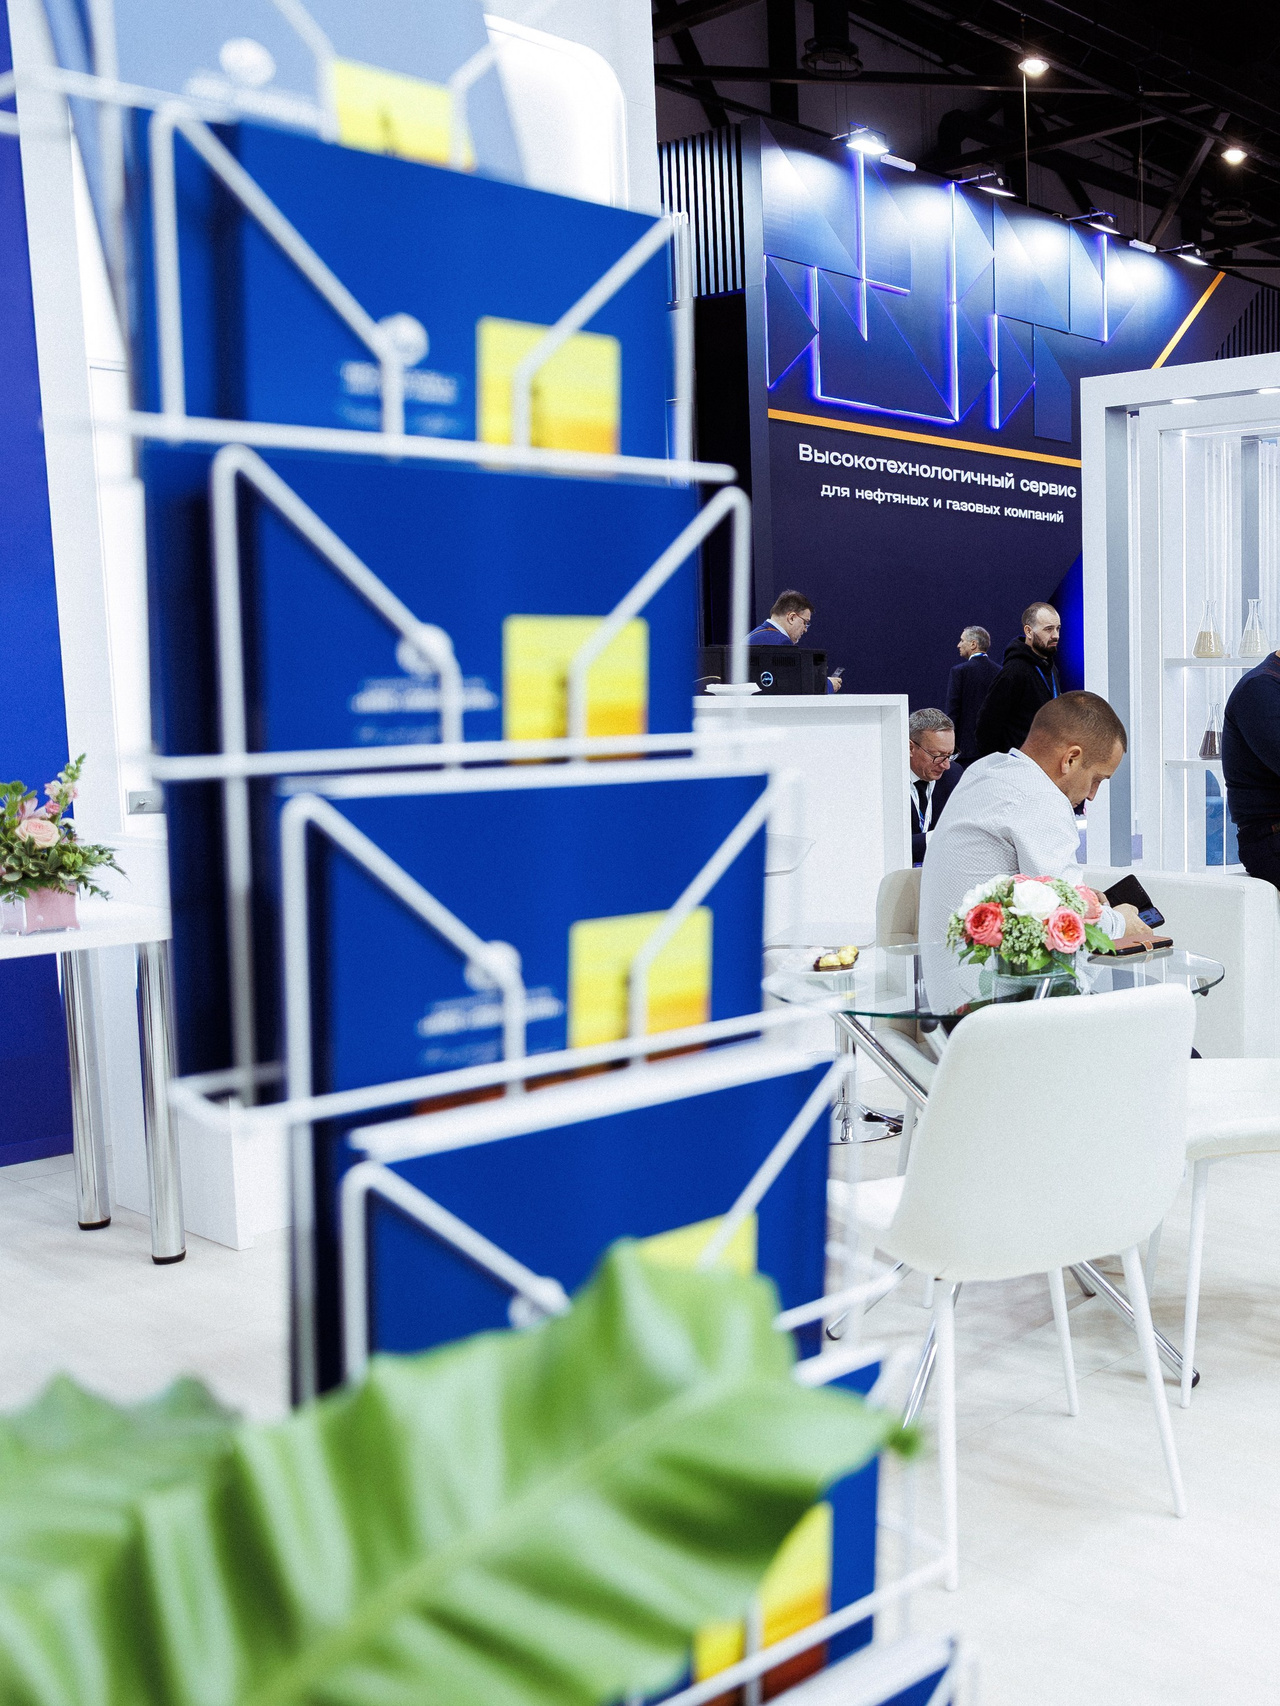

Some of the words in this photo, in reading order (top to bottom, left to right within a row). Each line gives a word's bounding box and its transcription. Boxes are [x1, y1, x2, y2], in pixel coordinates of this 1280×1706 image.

[798, 443, 1015, 490] Высокотехнологичный
[1019, 474, 1078, 499] сервис
[820, 484, 850, 498] для
[855, 487, 930, 508] нефтяных
[933, 499, 943, 508] и
[946, 499, 1001, 516] газовых
[1004, 506, 1064, 523] компаний
